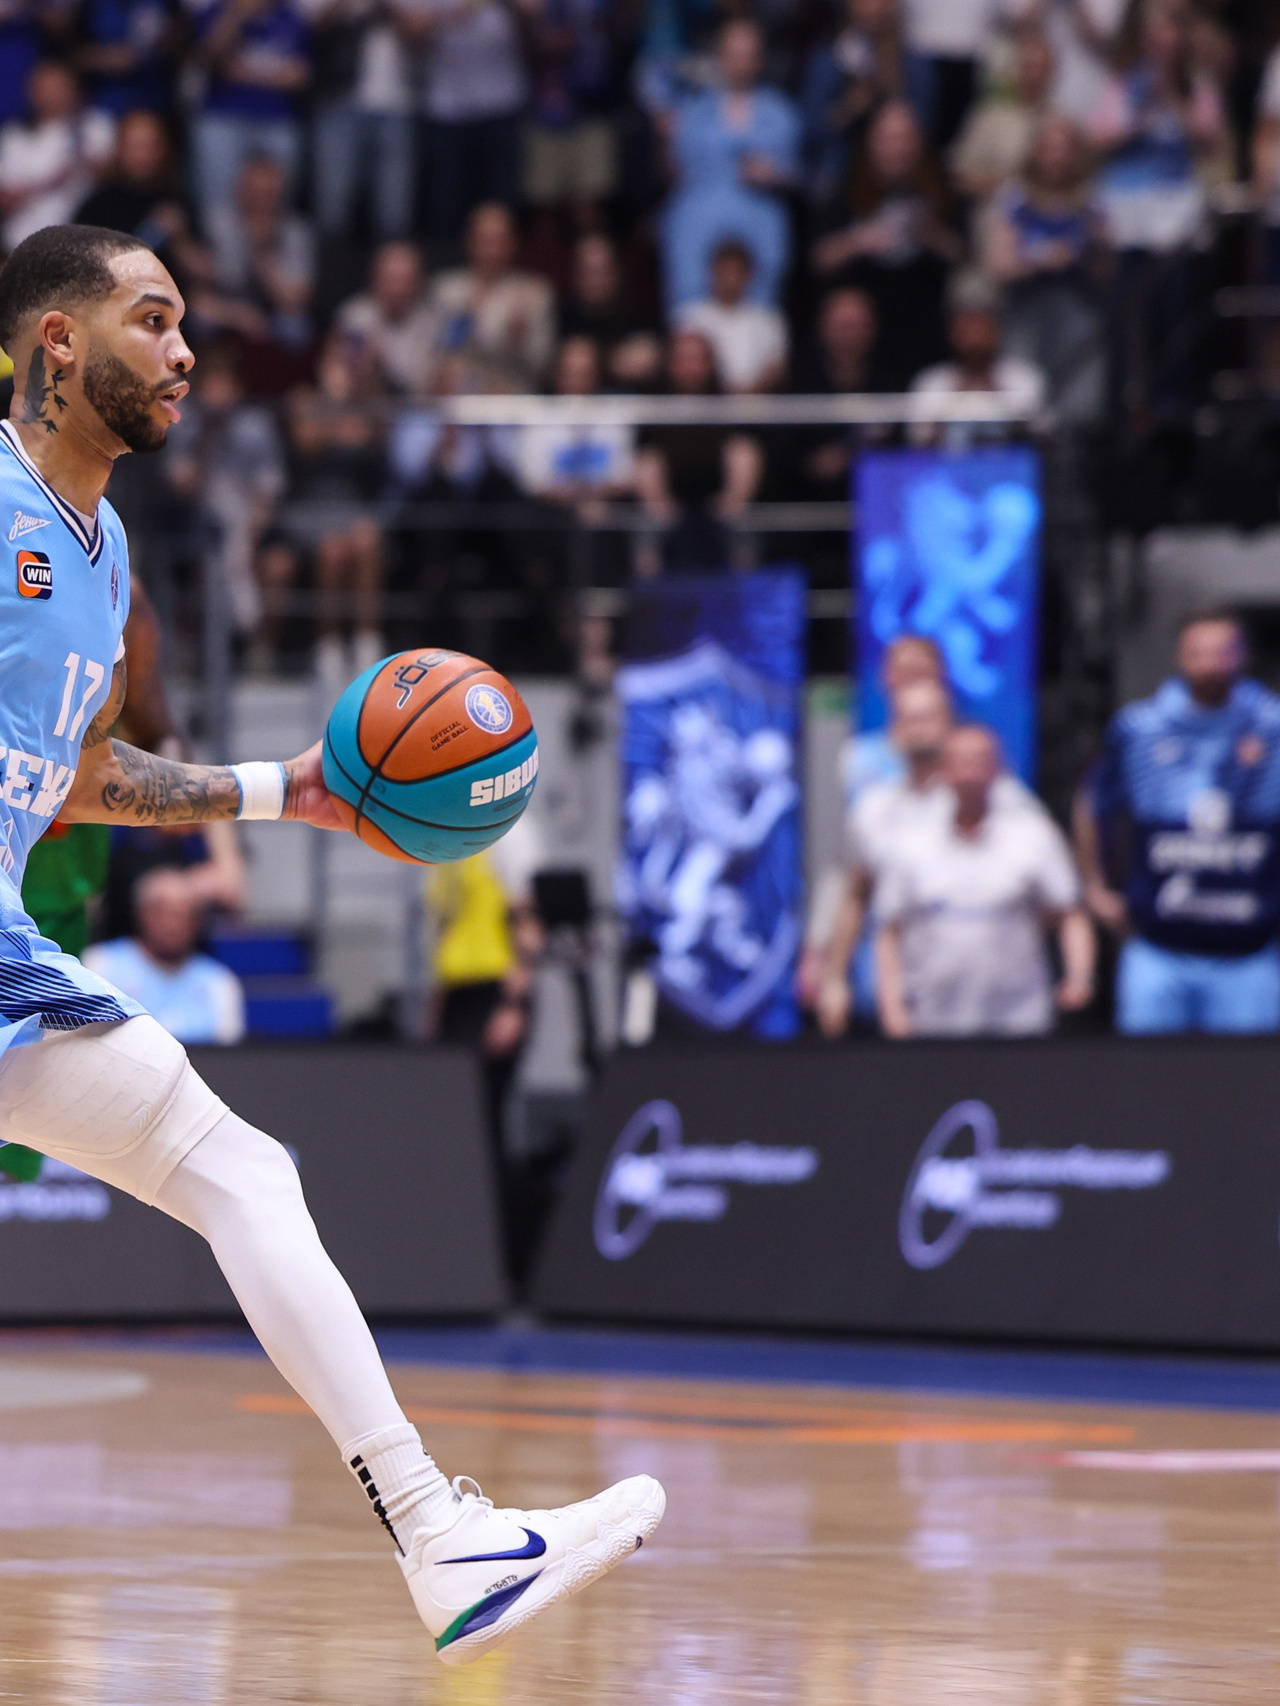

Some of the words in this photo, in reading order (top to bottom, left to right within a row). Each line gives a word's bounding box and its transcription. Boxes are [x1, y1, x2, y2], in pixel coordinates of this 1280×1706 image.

[26, 567, 52, 584] WIN
[53, 651, 105, 742] 17
[430, 721, 462, 743] OFFICIAL
[431, 735, 452, 751] GAME
[452, 725, 469, 739] BALL
